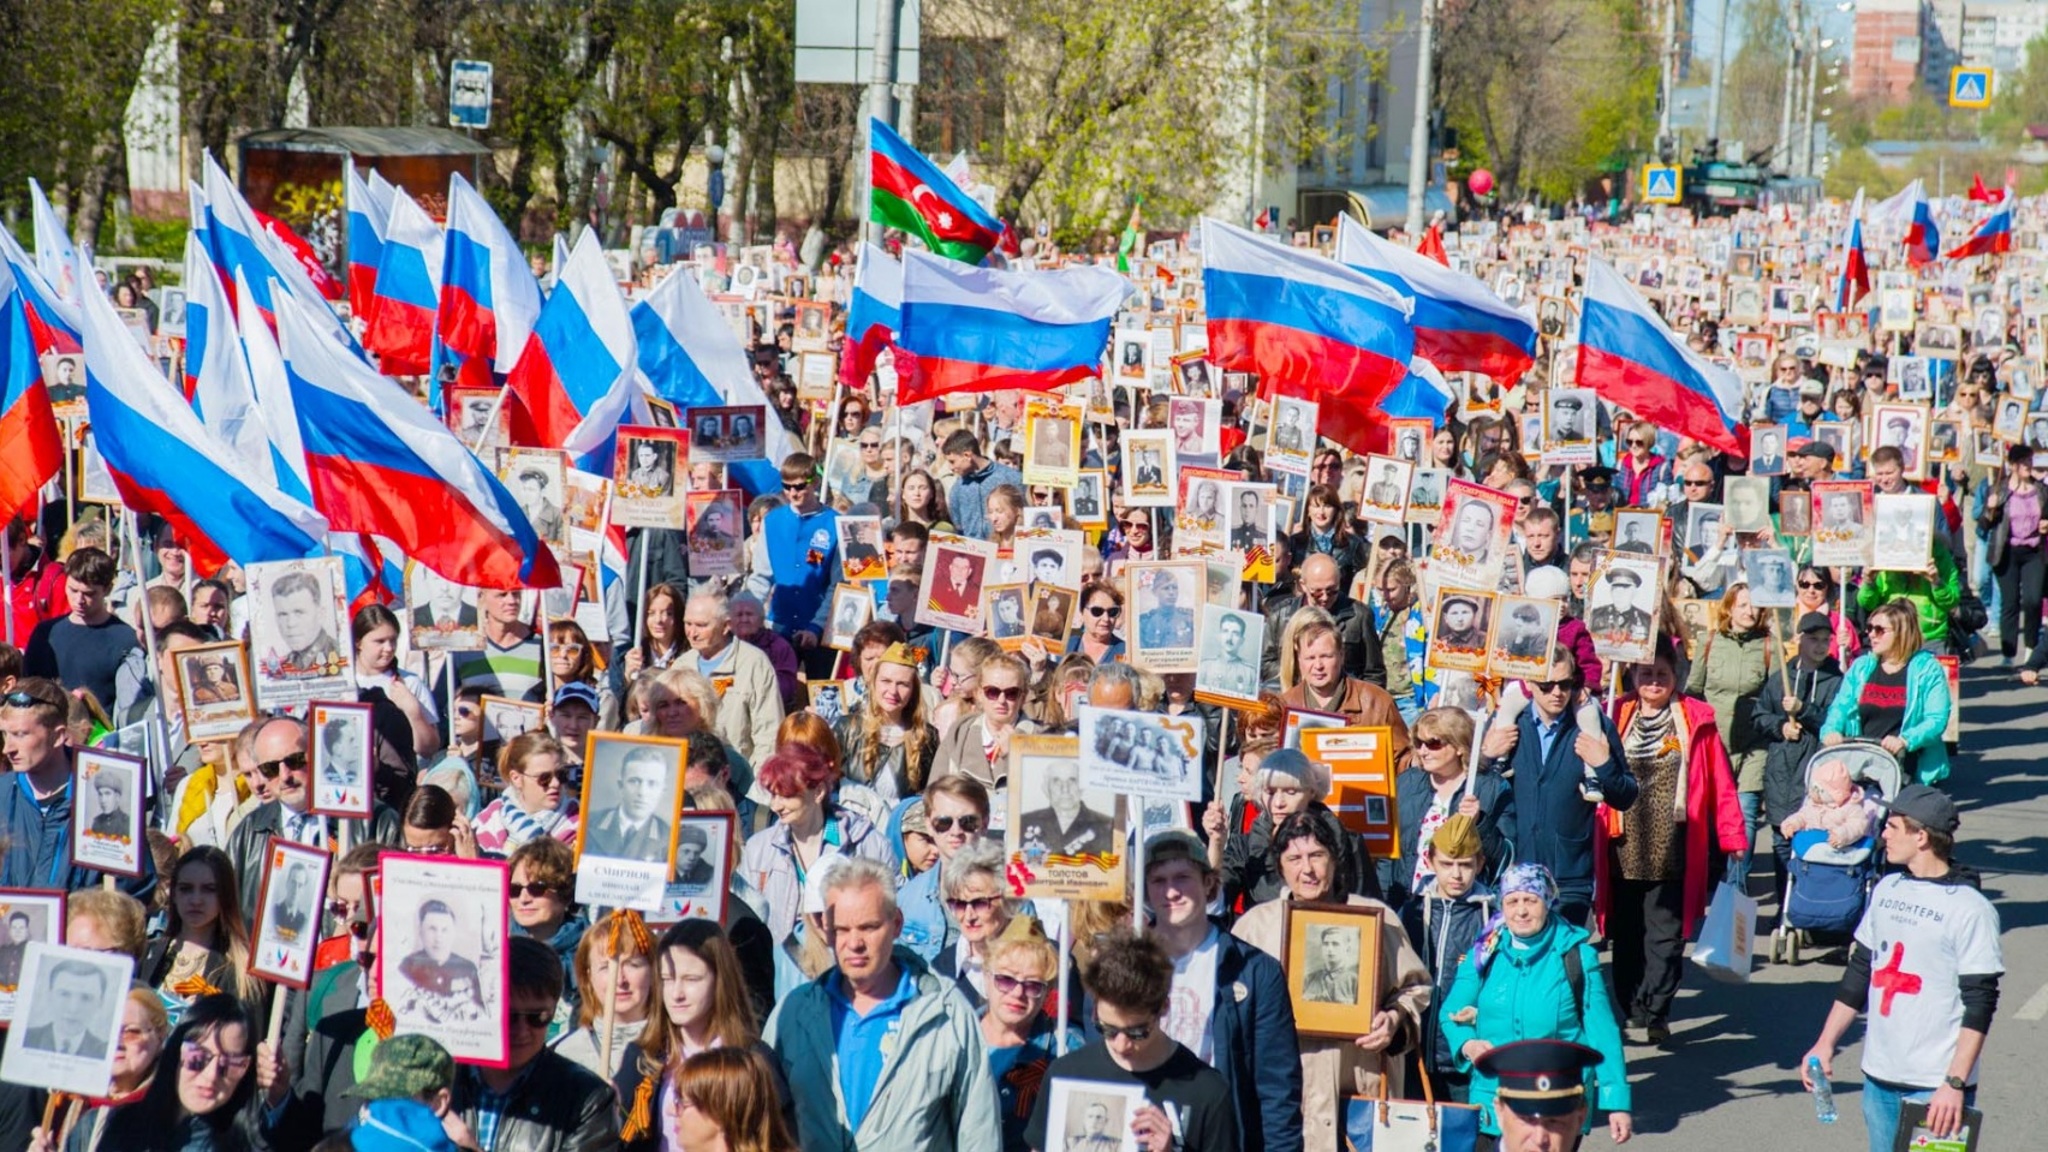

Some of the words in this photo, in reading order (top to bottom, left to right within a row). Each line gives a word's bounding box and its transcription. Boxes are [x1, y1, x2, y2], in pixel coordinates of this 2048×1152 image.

[594, 867, 650, 879] СМИРНОВ
[1048, 869, 1089, 878] ТОЛСТОВ
[1878, 898, 1945, 922] ВОЛОНТЕРЫ
